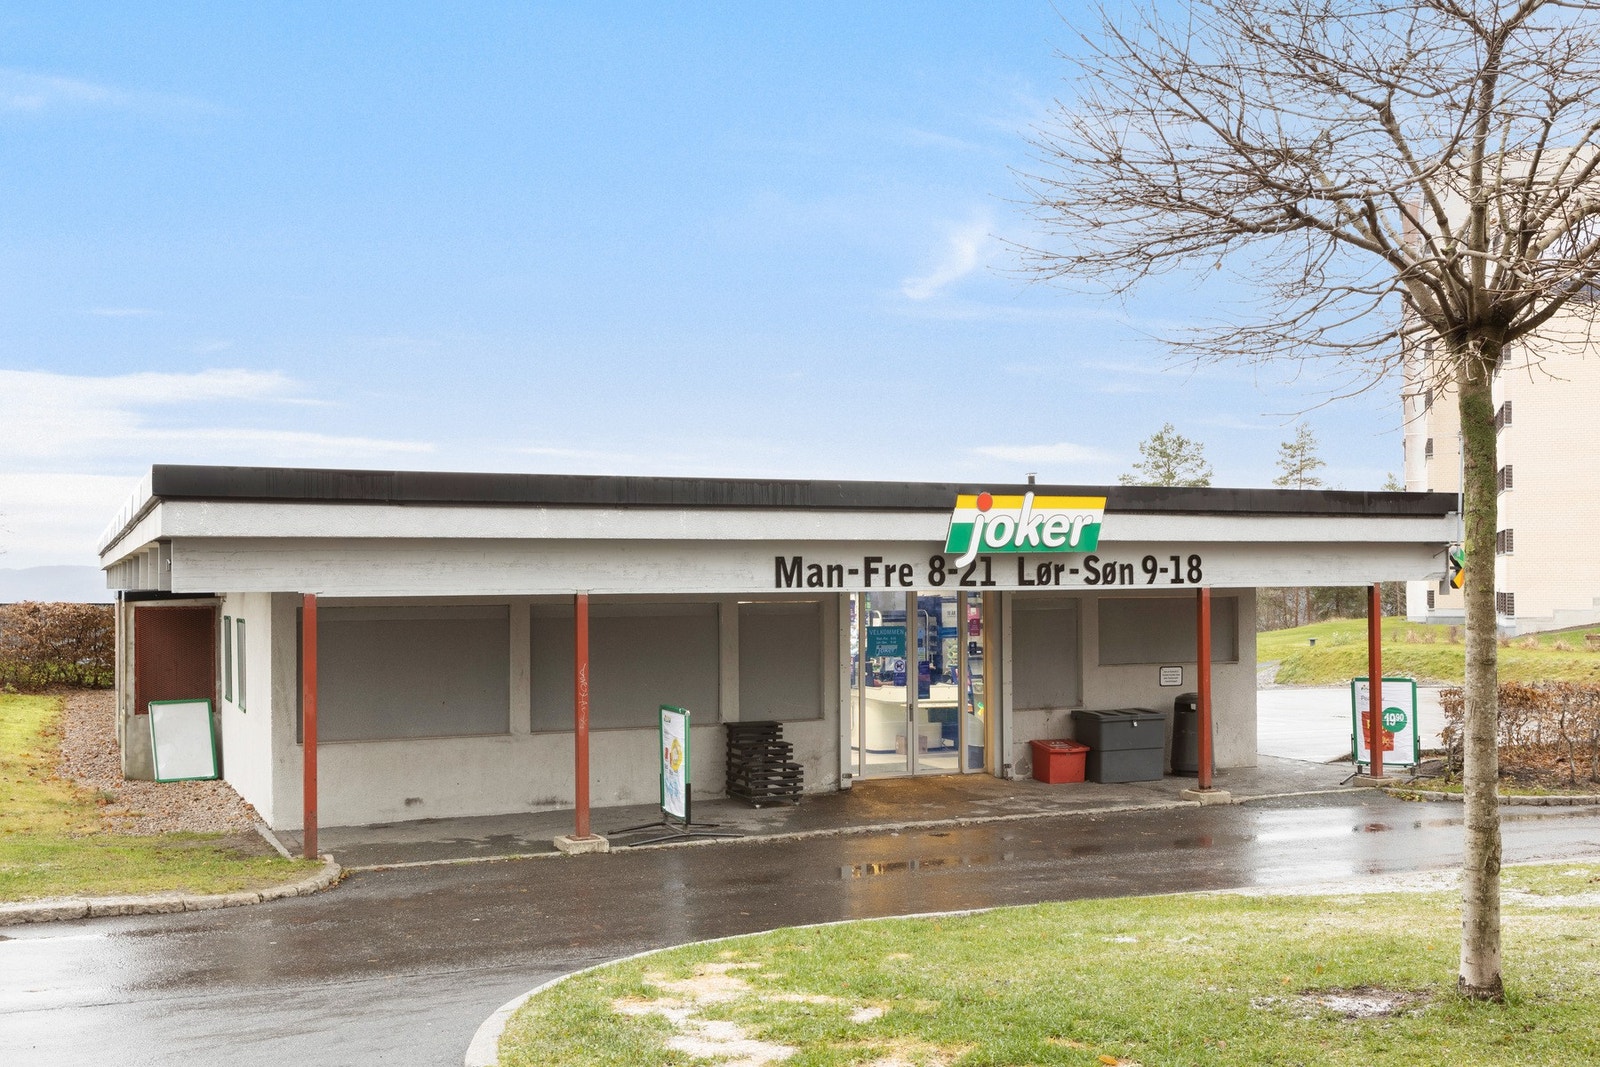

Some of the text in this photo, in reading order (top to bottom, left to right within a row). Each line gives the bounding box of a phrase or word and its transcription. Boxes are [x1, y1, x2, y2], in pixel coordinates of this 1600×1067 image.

[954, 491, 1095, 568] joker
[775, 554, 1203, 588] Man-Fre 8-21 Lør-Søn 9-18
